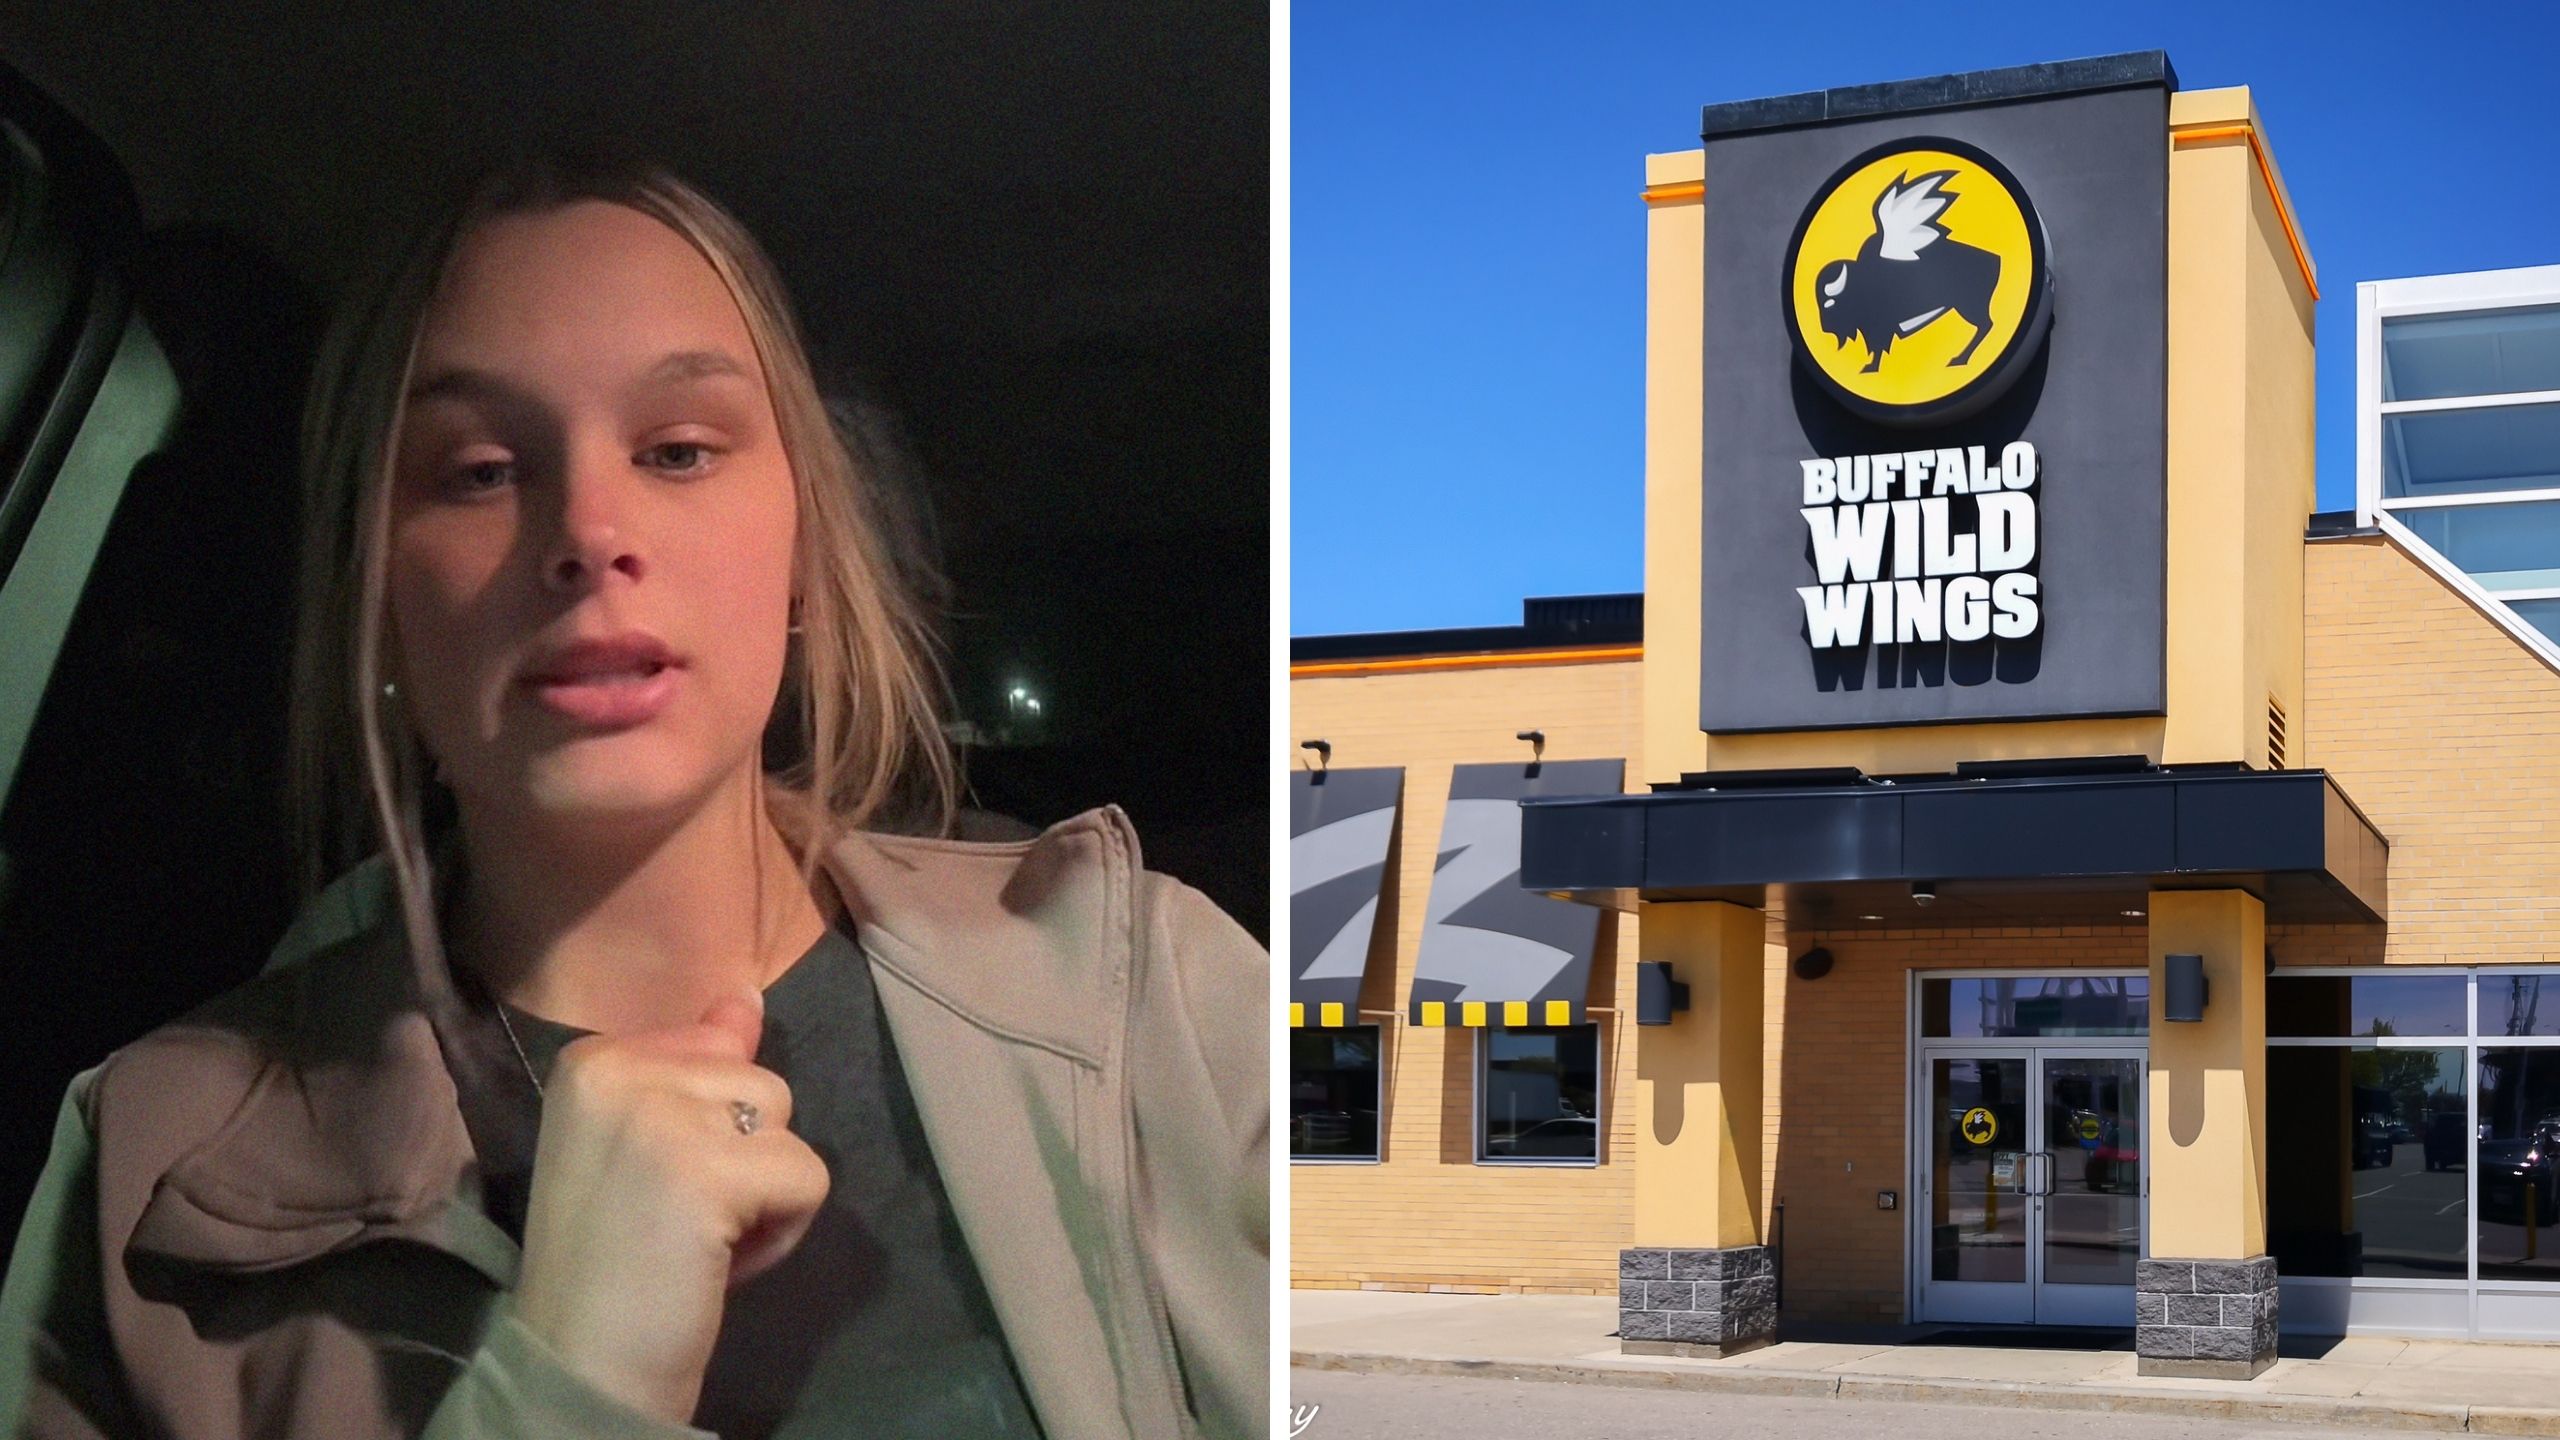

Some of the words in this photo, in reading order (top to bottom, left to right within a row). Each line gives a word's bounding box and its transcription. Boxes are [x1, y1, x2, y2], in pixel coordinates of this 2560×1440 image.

[1800, 441, 2036, 505] BUFFALO
[1800, 491, 2036, 584] WILD
[1796, 572, 2039, 648] WINGS
